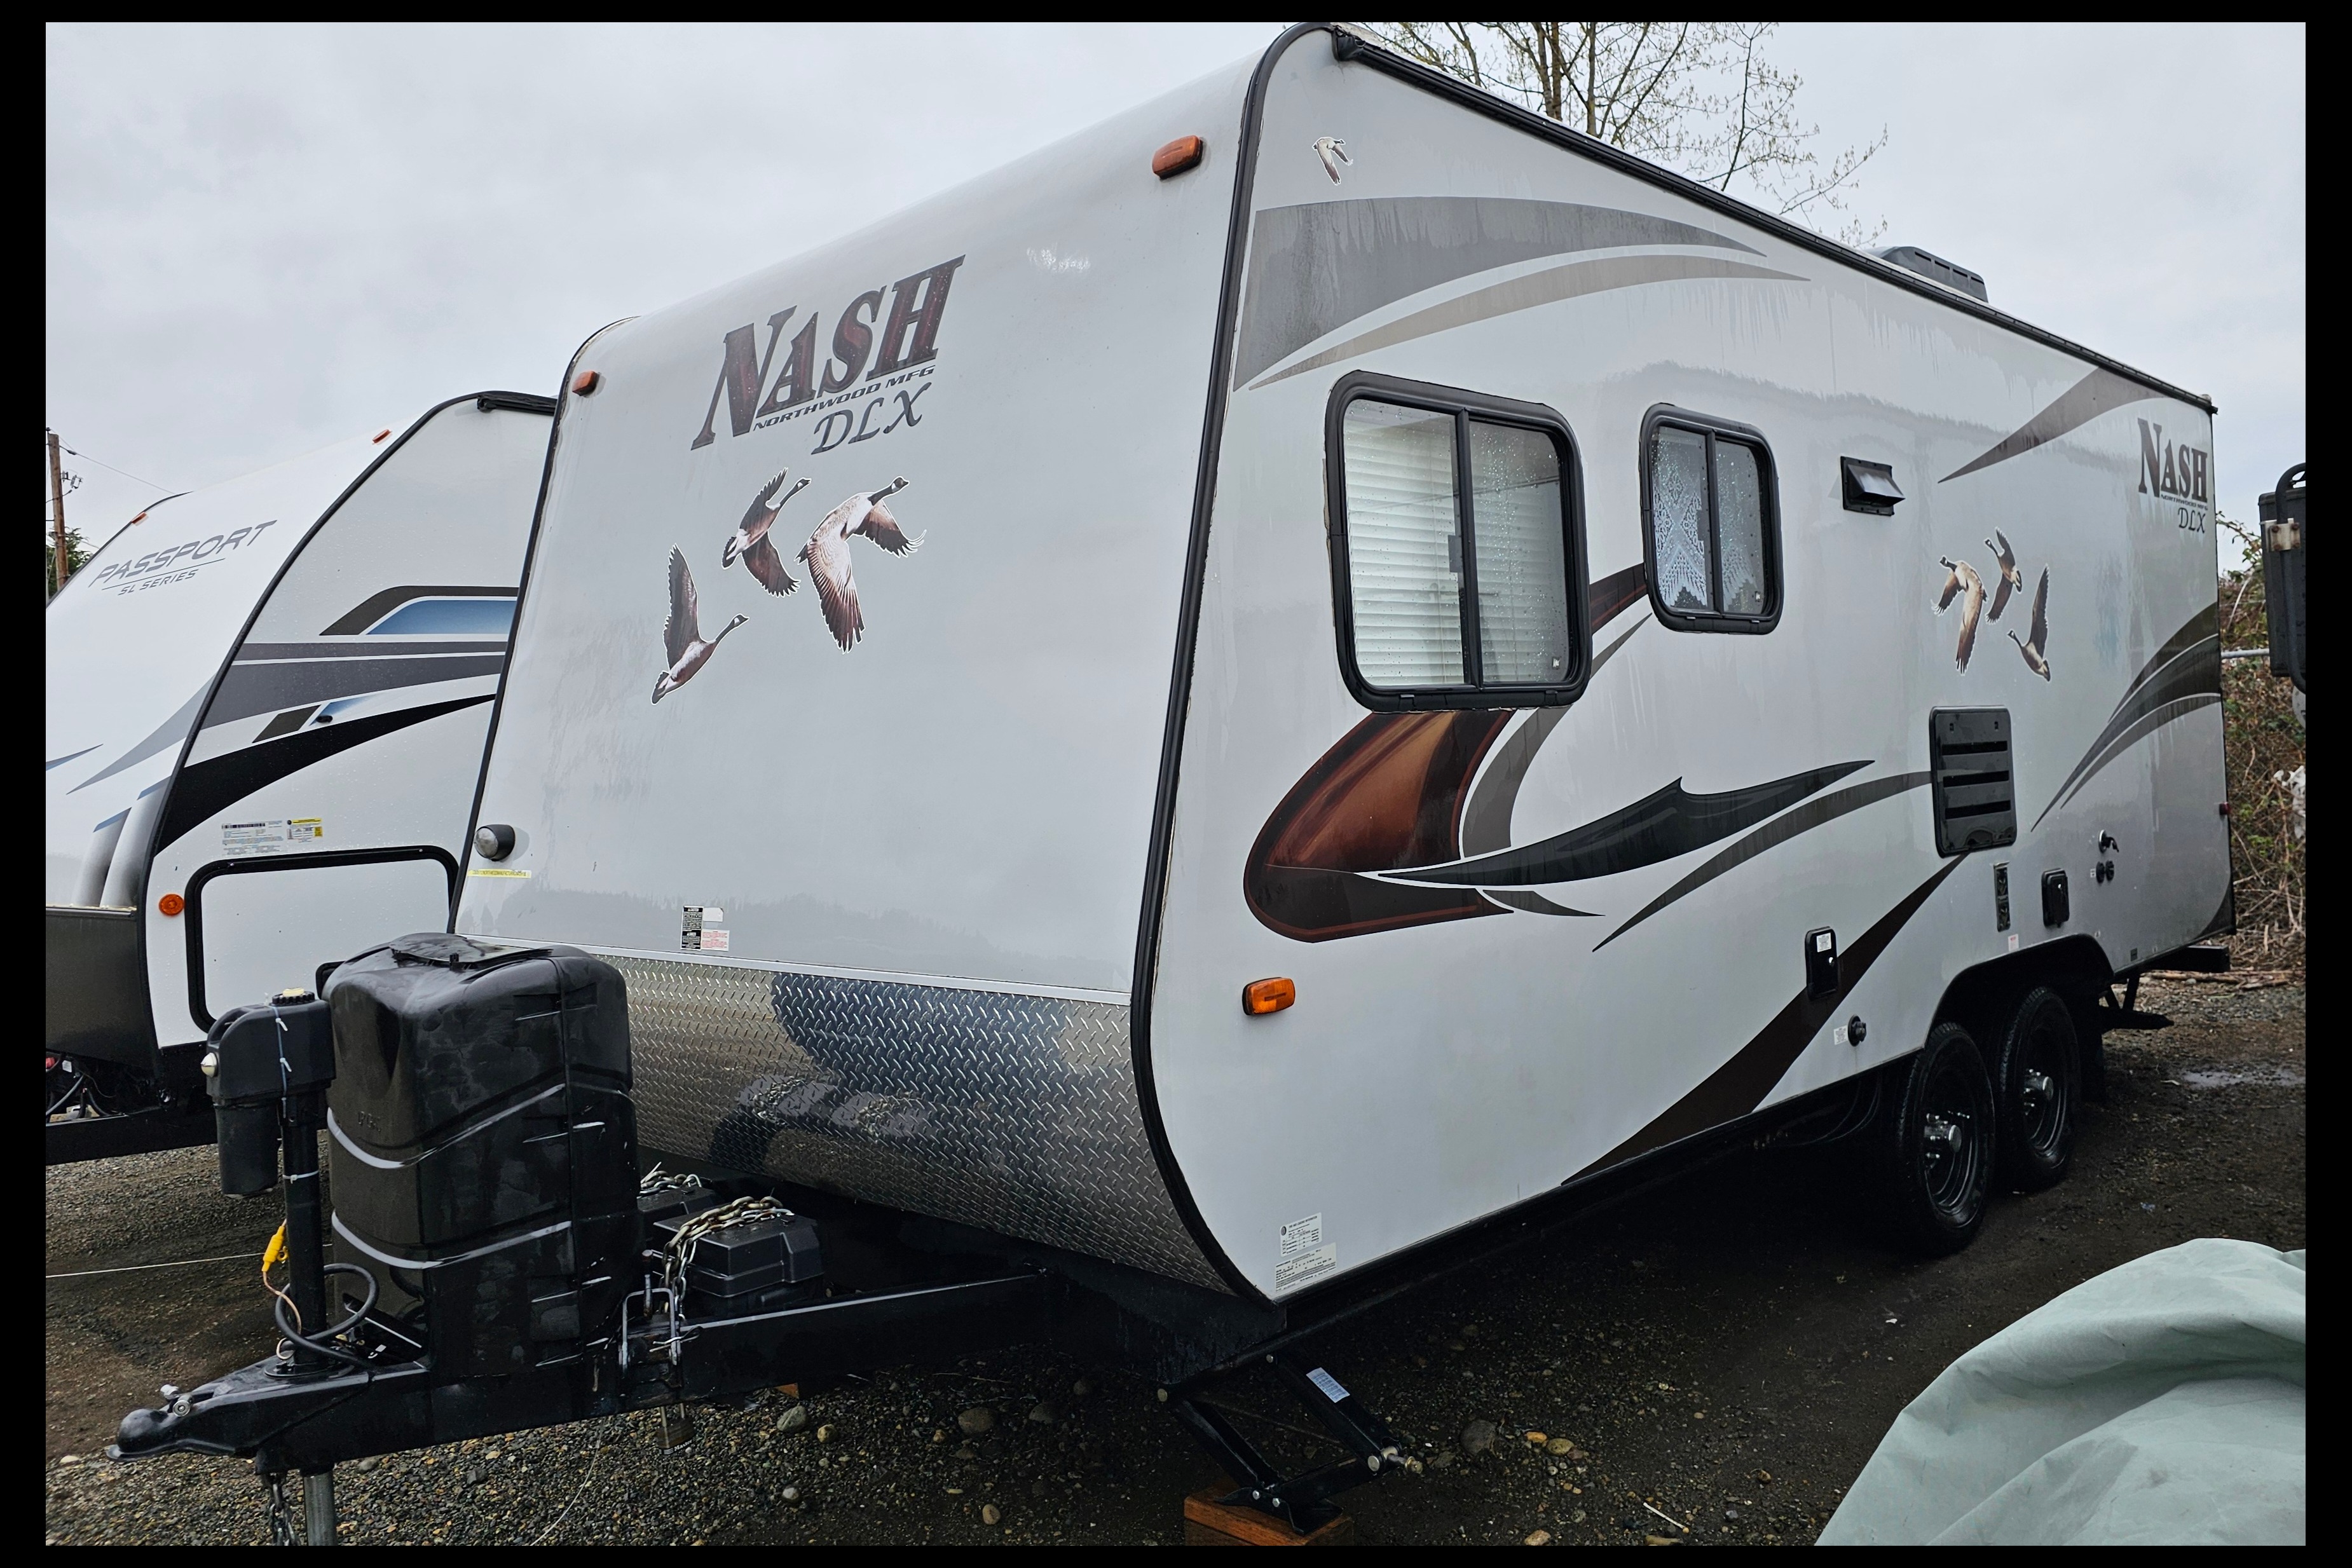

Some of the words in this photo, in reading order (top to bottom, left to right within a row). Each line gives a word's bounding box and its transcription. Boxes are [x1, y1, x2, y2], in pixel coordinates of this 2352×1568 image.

[691, 254, 966, 451] NASH
[753, 382, 881, 431] NORTHWOOD
[885, 365, 935, 388] MFG
[811, 382, 932, 455] DLX
[2138, 418, 2208, 503] NASH
[2161, 494, 2196, 507] NORTHWOOD
[2178, 508, 2206, 534] DLX
[88, 520, 277, 587] PASSPORT
[118, 586, 135, 596] SL
[139, 569, 199, 590] SERIES
